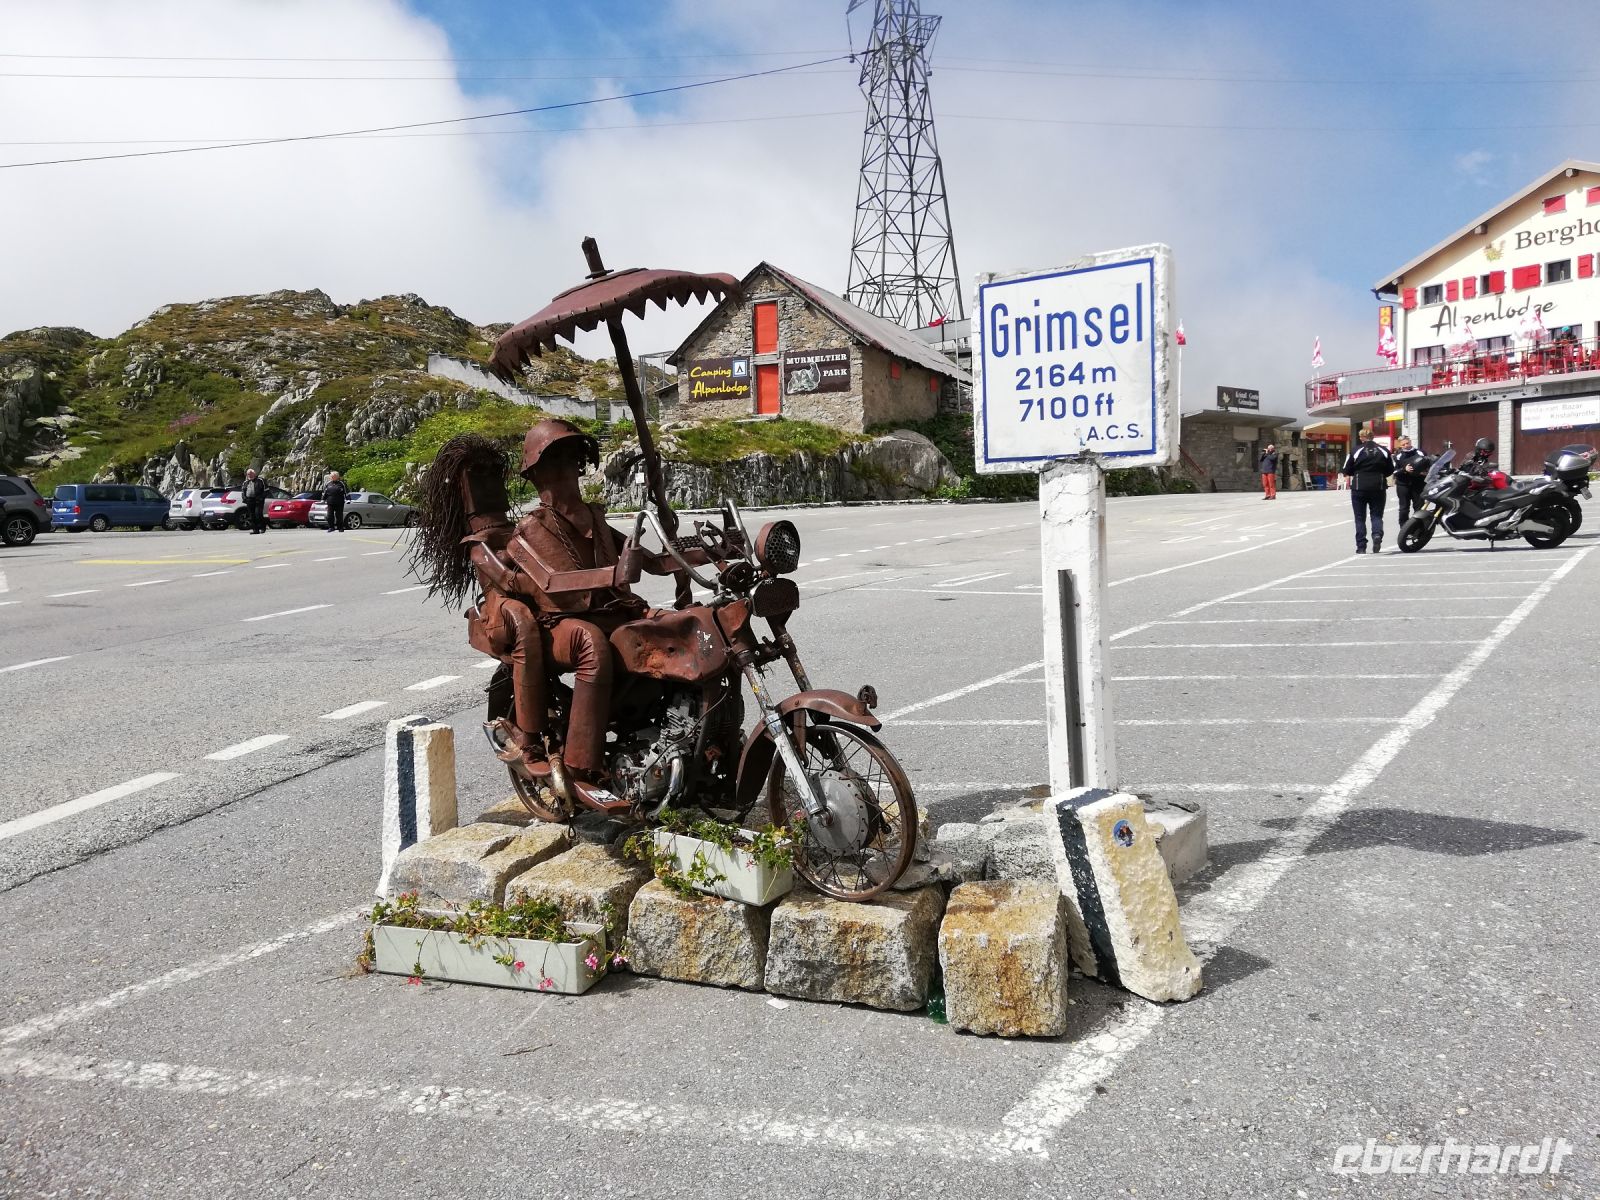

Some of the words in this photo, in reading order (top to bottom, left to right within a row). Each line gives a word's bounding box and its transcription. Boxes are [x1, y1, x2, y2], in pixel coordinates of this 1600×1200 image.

[990, 282, 1143, 358] Grimsel
[786, 353, 848, 366] MURMELTIER
[690, 366, 732, 380] Camping
[822, 368, 848, 378] PARK
[690, 380, 749, 399] Alpenlodge
[1086, 422, 1145, 441] A.C.S.
